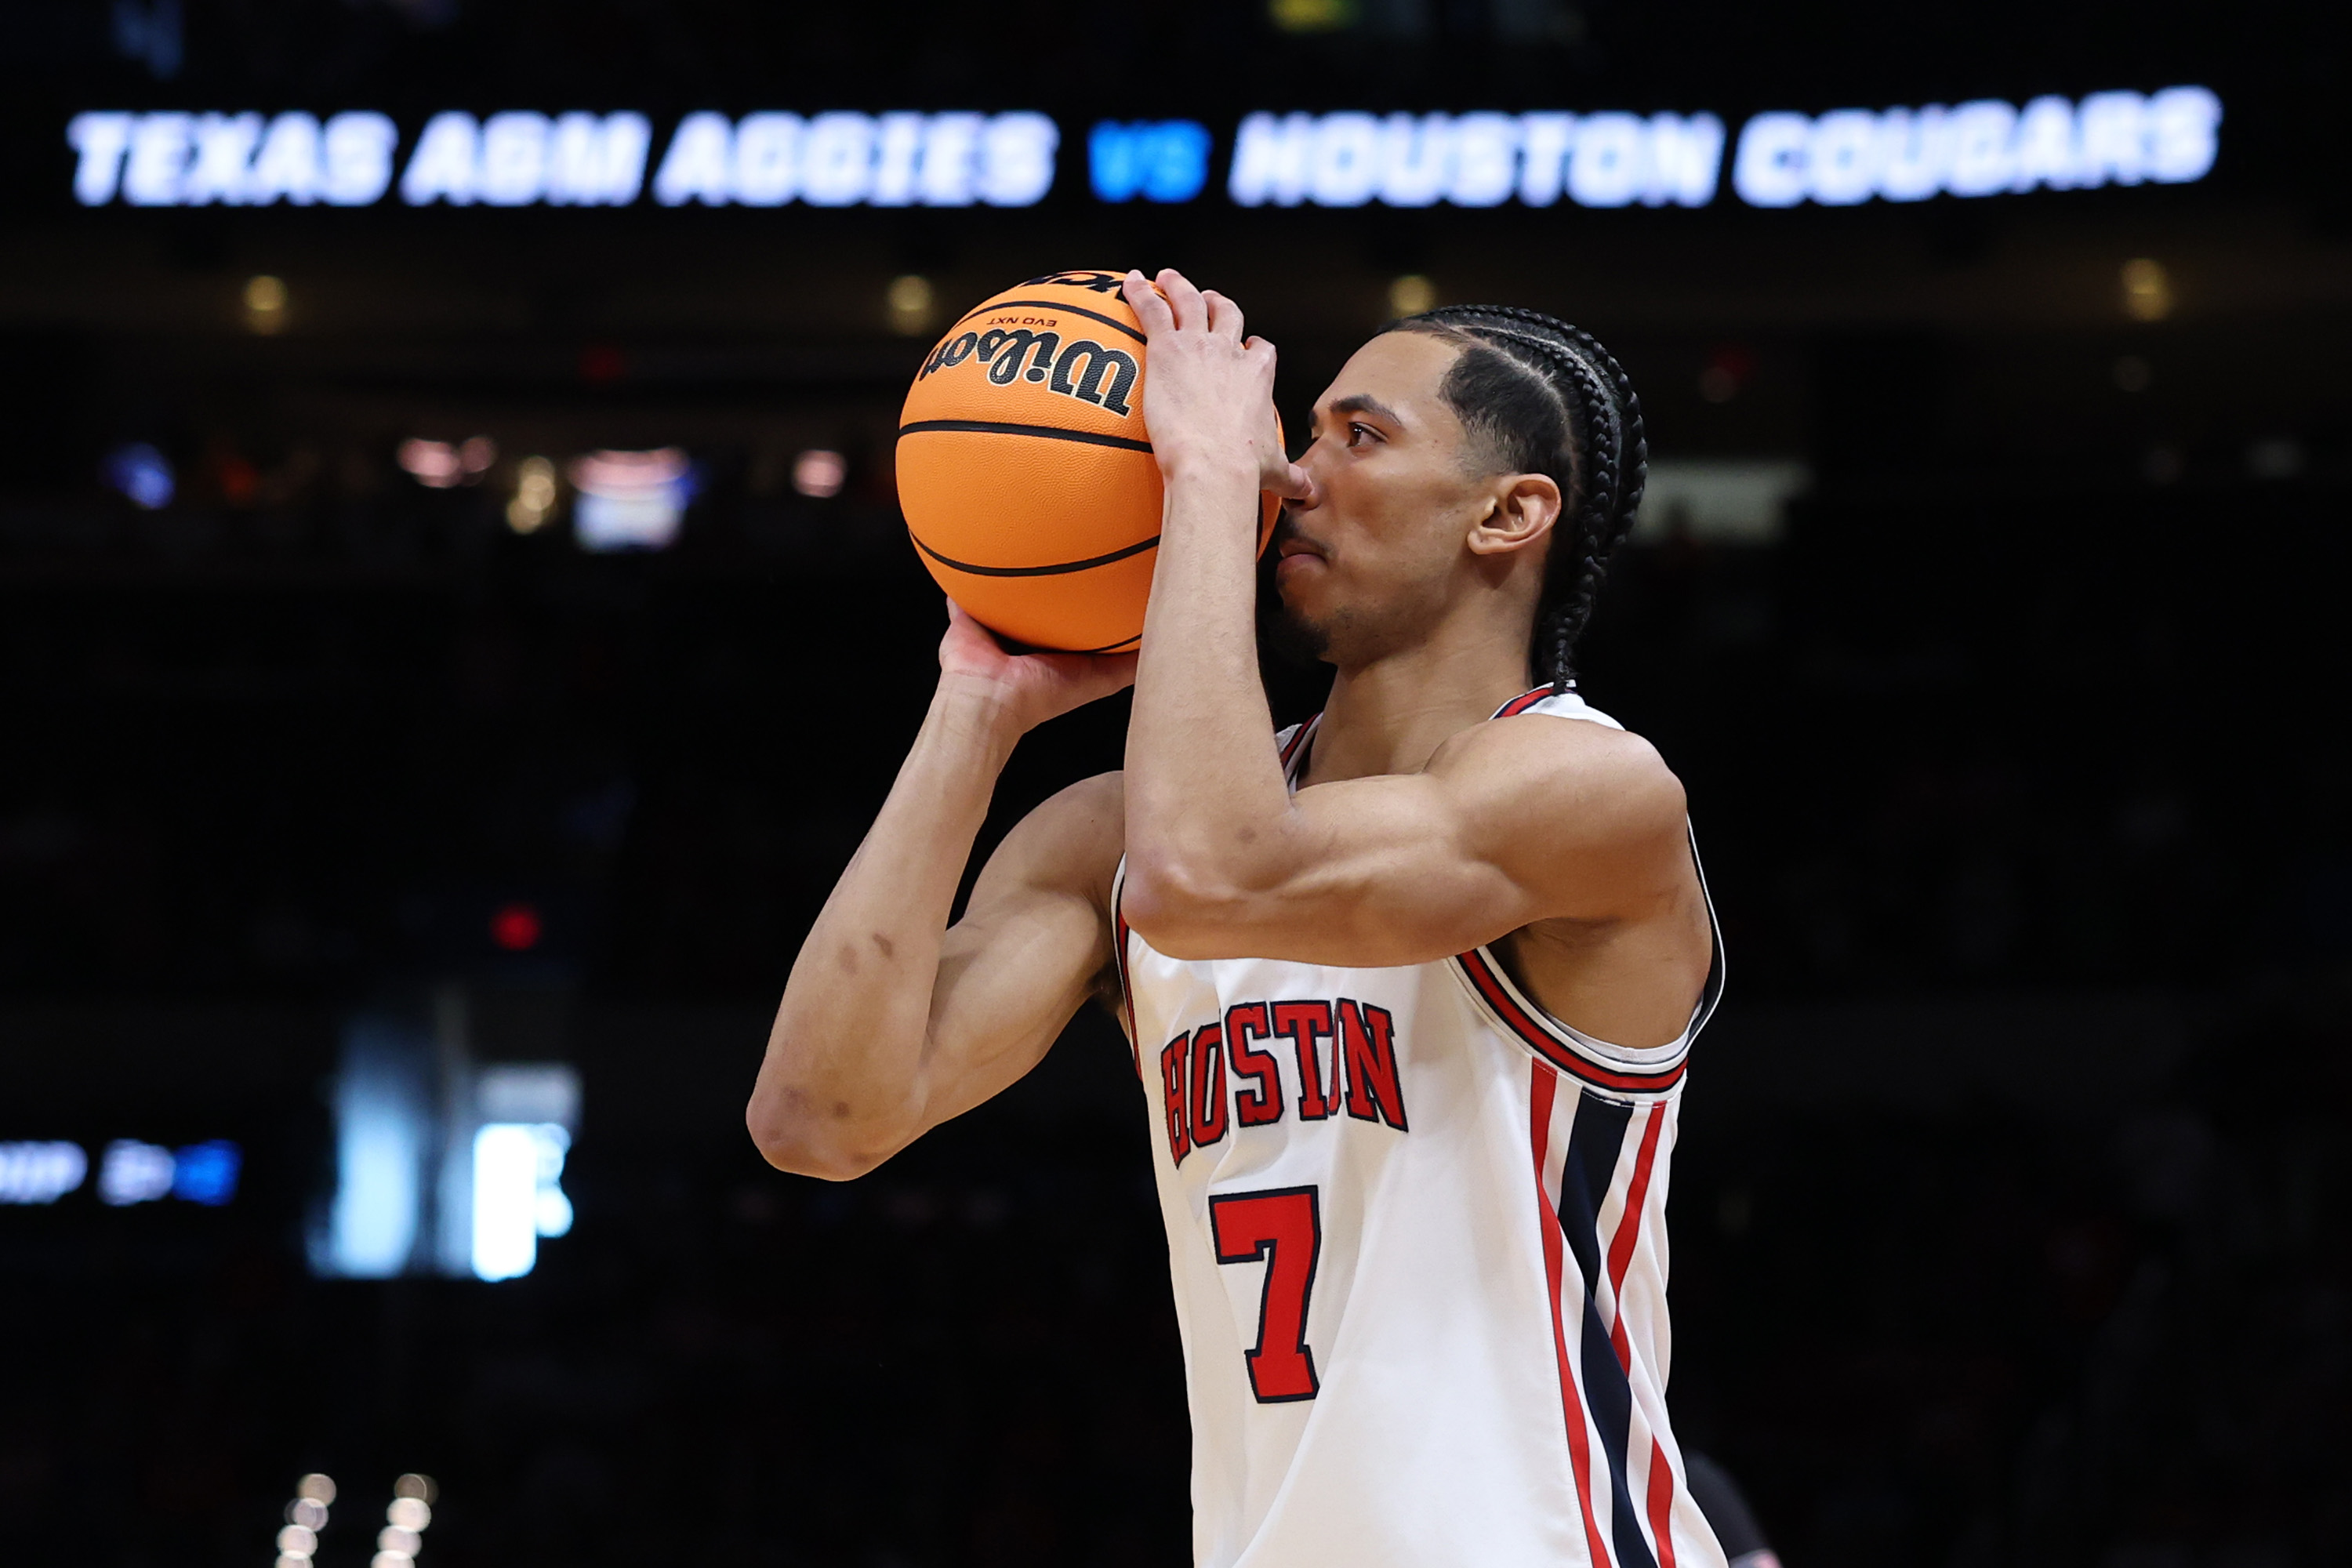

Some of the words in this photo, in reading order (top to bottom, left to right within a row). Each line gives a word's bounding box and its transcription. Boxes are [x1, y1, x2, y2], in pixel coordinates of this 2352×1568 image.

[68, 111, 397, 206] TEXAS
[401, 111, 652, 207] A&M
[652, 111, 1058, 207] AGGIES
[1088, 119, 1212, 203] VS
[1229, 111, 1725, 208] HOUSTON
[1733, 85, 2222, 208] COUGARS
[919, 328, 1139, 418] Wilson
[986, 317, 1019, 325] NXT
[1022, 318, 1058, 327] EVO
[1161, 997, 1409, 1170] HOSTN
[1208, 1185, 1321, 1403] 7
